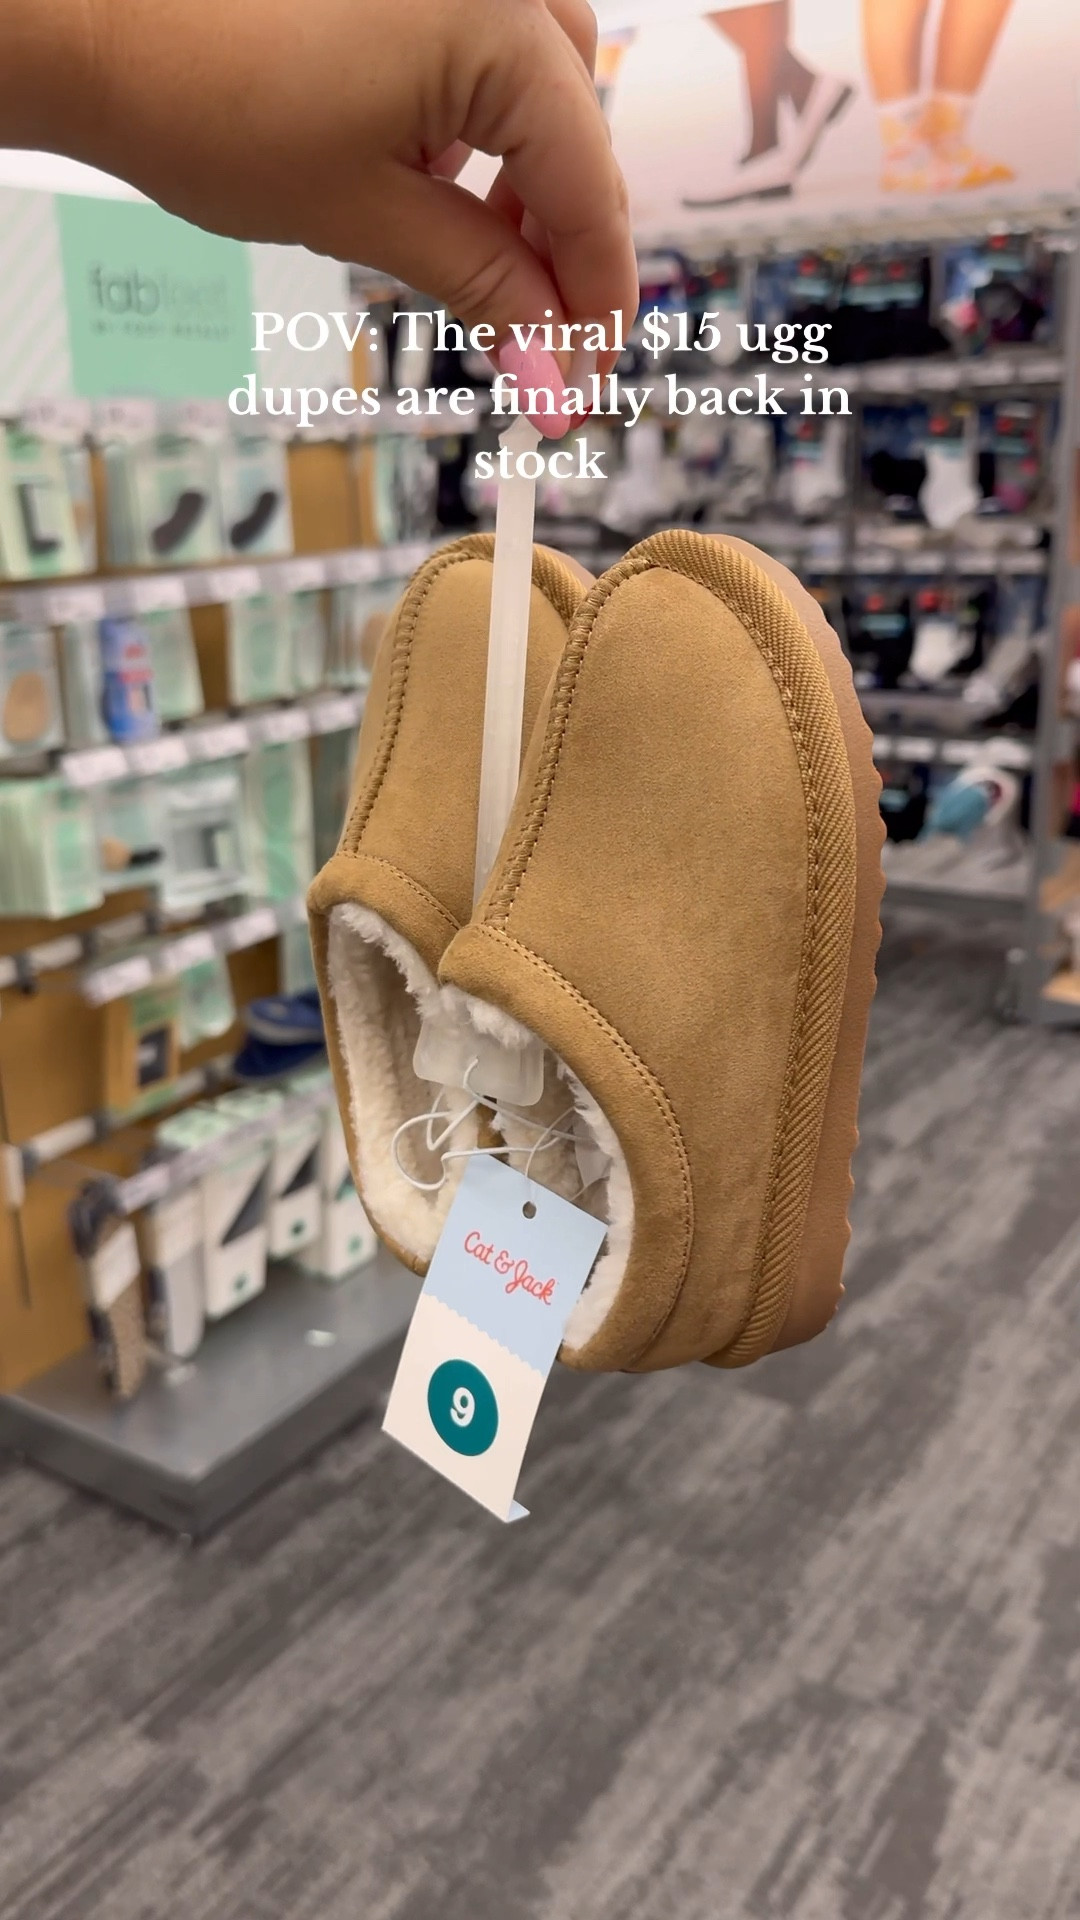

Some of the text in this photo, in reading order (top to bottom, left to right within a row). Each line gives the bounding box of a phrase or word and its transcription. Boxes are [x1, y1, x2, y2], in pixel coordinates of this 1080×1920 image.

[464, 1231, 555, 1305] Cat & Jack
[450, 1387, 475, 1427] 9
